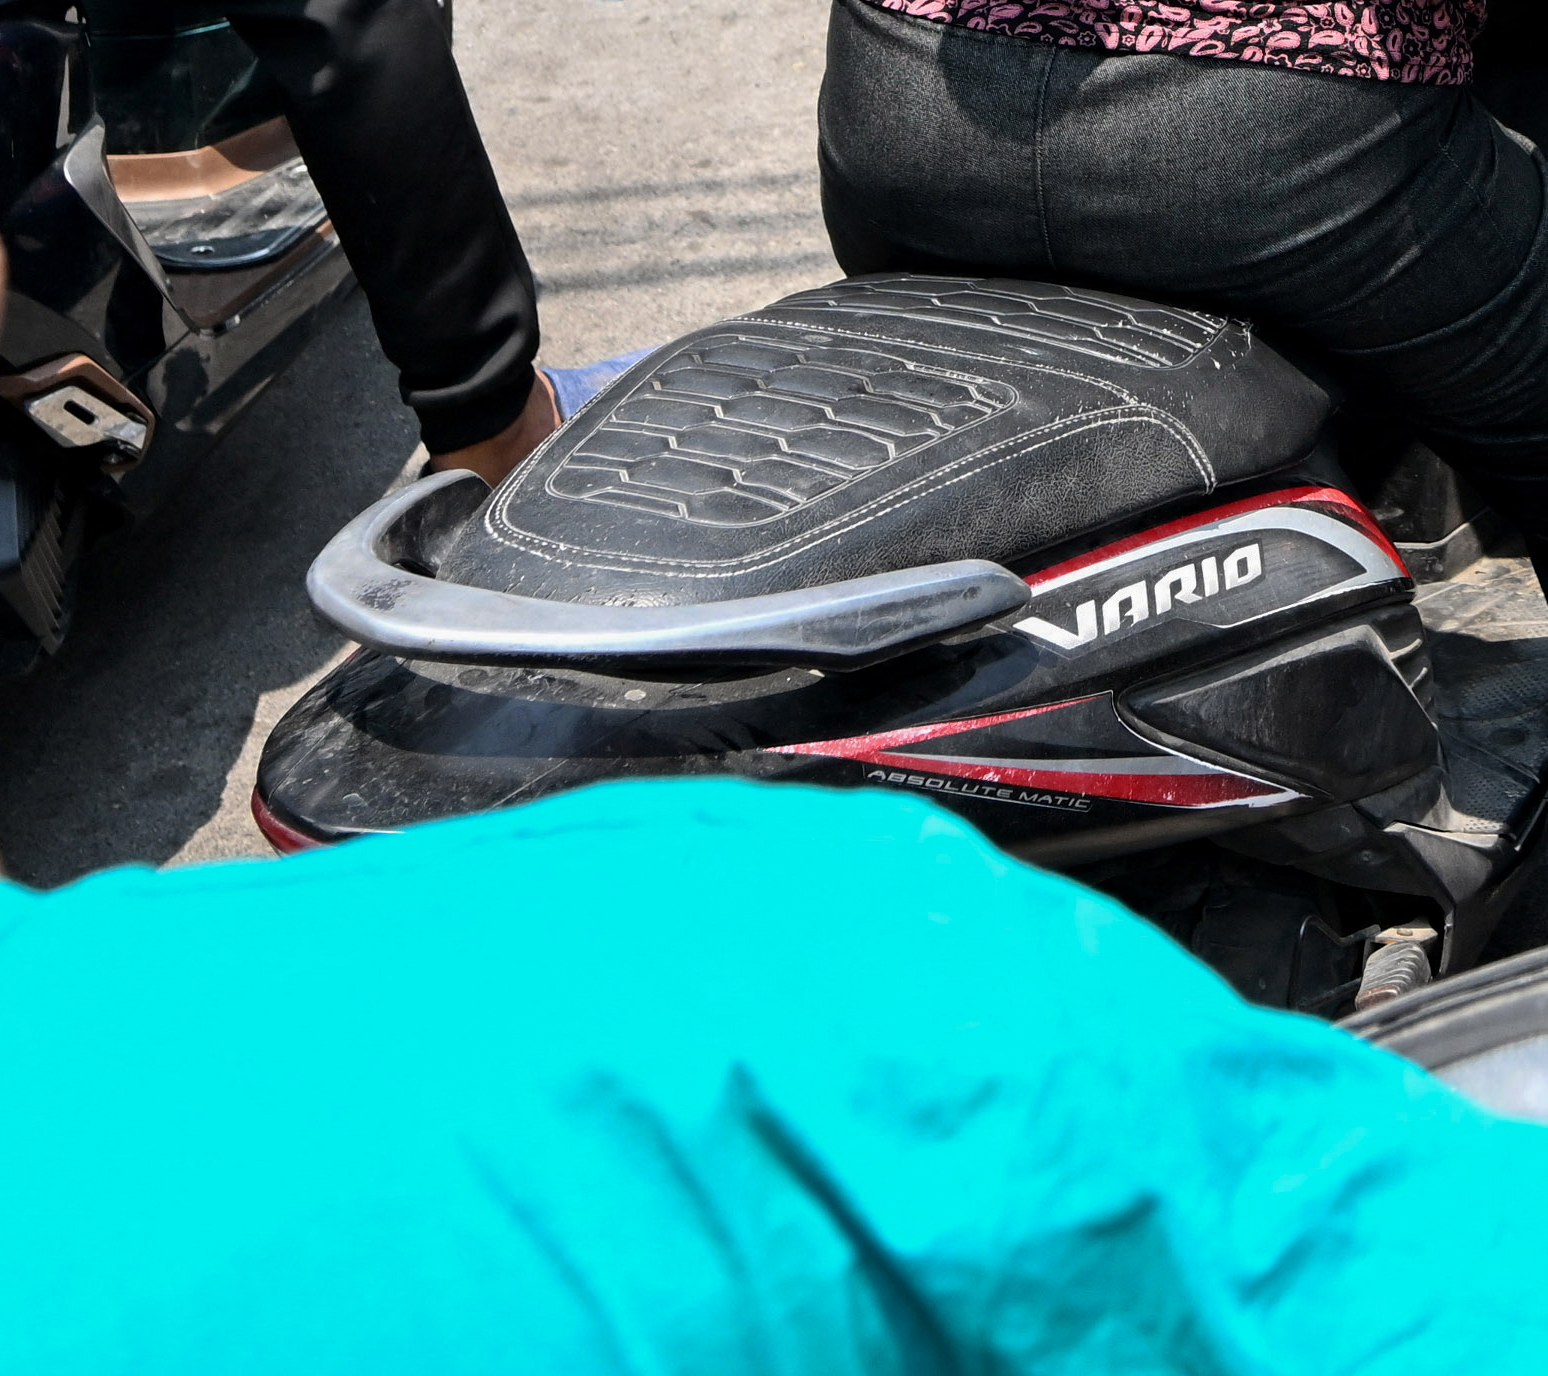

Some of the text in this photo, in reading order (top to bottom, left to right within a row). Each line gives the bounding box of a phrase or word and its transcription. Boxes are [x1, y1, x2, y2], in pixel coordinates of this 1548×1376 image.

[1012, 542, 1263, 650] VARIO
[866, 769, 1091, 810] ABSOLUTE MATIC
